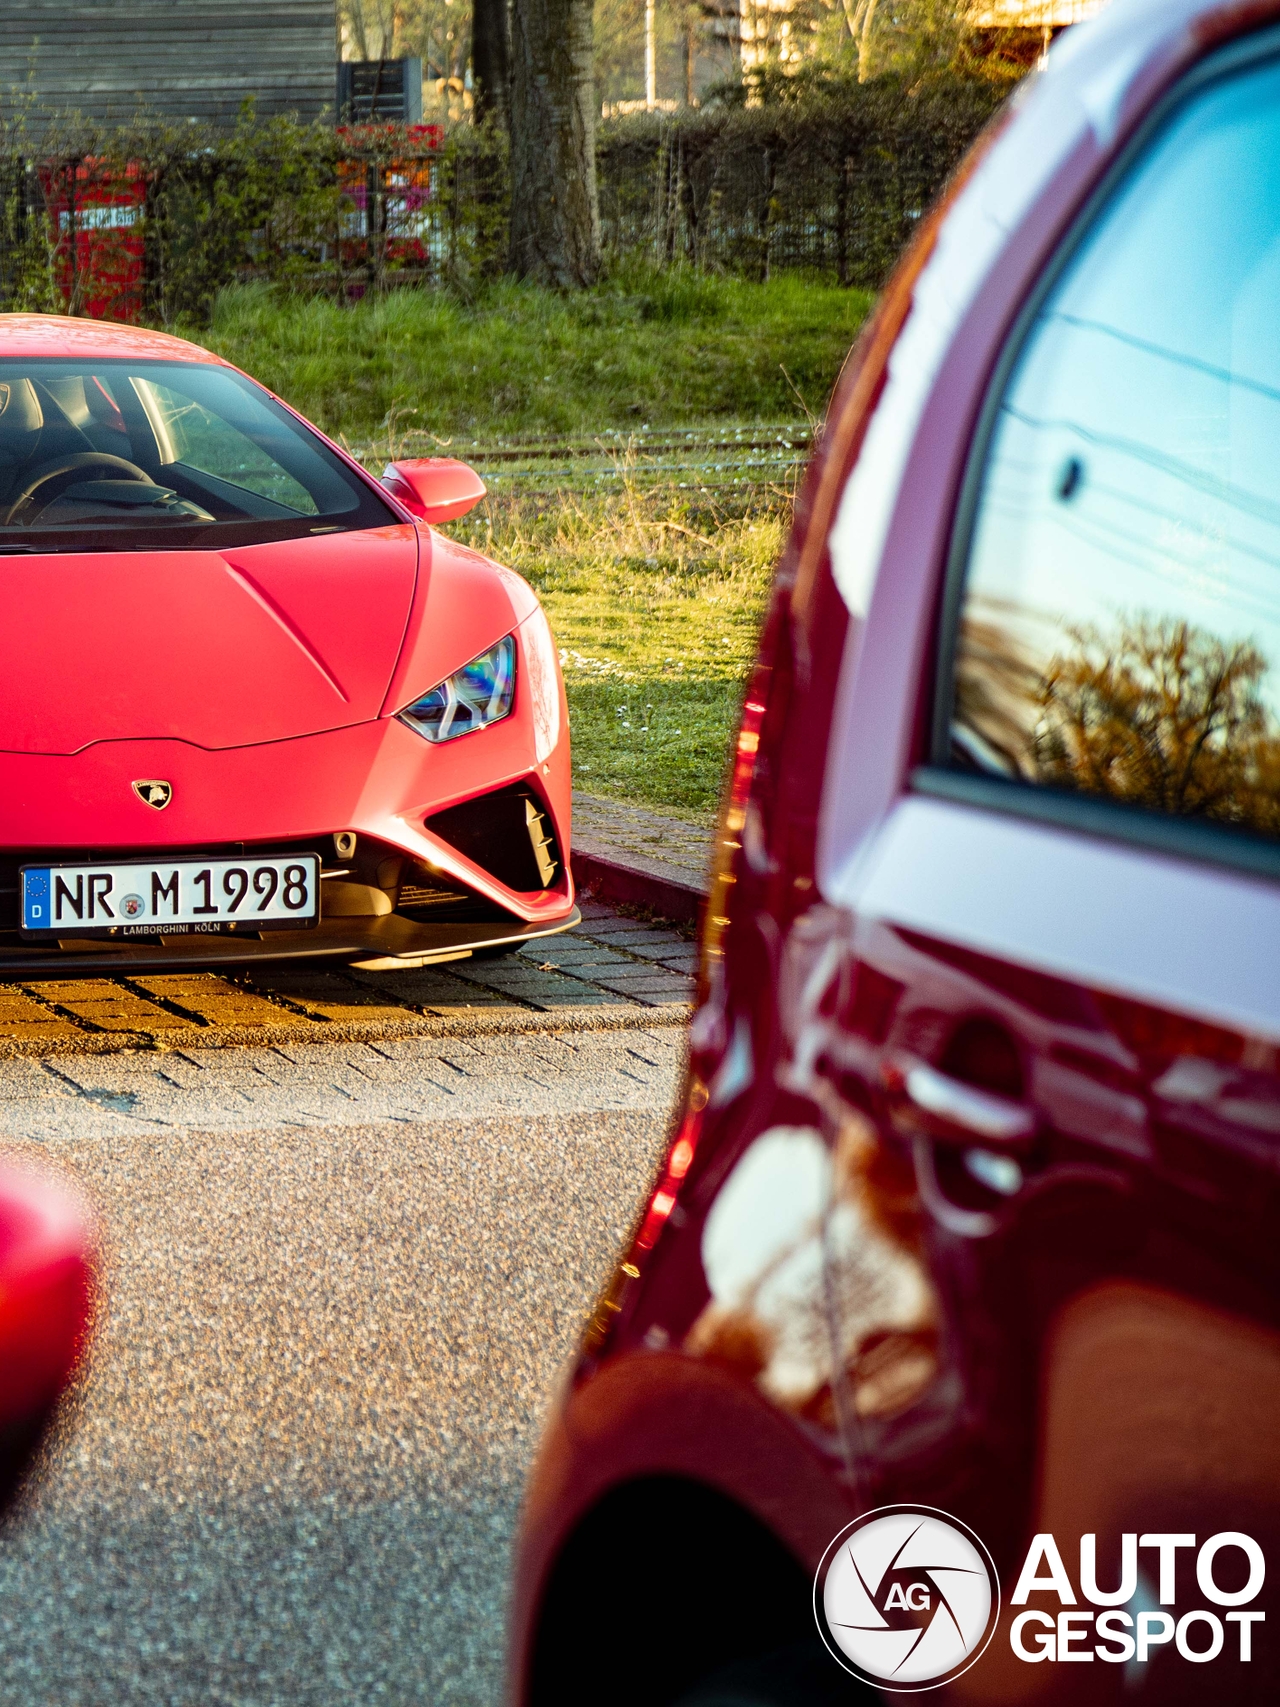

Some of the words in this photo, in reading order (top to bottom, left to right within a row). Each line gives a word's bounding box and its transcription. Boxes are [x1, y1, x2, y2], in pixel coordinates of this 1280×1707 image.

[55, 873, 115, 920] NR
[151, 870, 179, 916] M
[192, 864, 308, 914] 1998
[31, 905, 42, 918] D
[123, 924, 189, 935] LAMBORGHINI
[194, 921, 220, 932] KÖLN
